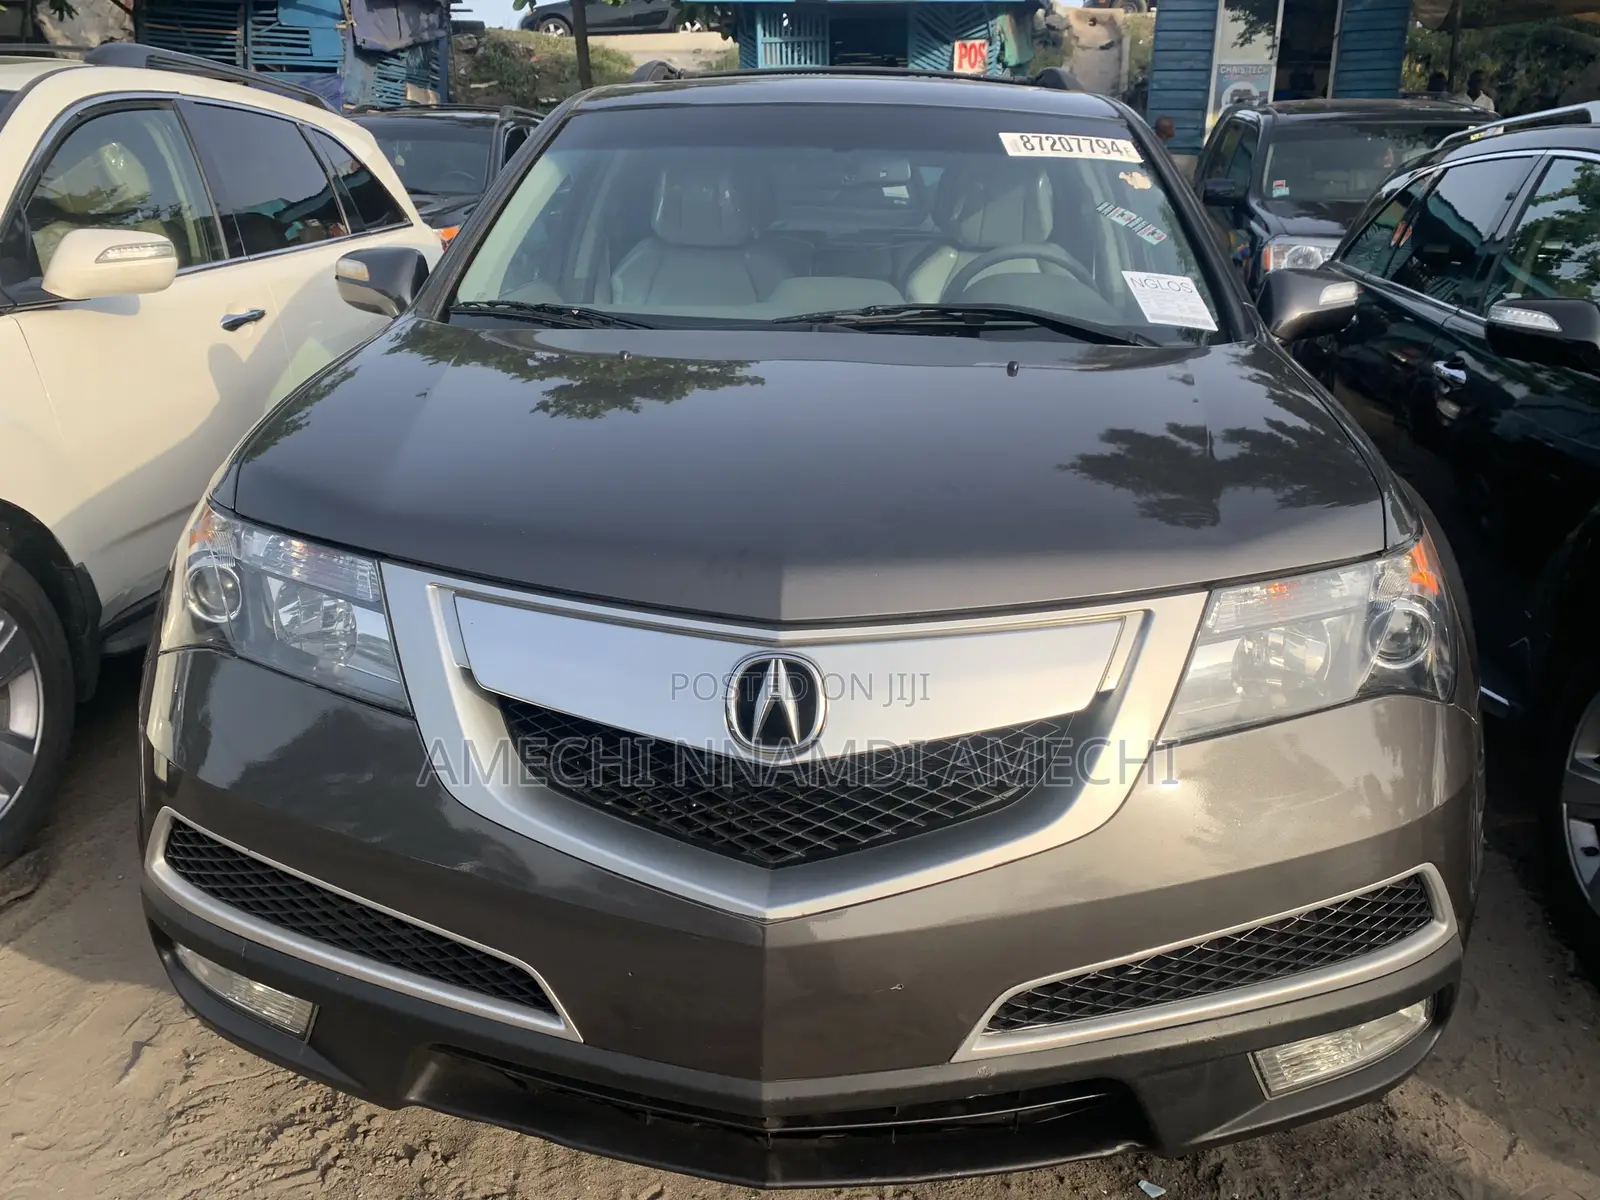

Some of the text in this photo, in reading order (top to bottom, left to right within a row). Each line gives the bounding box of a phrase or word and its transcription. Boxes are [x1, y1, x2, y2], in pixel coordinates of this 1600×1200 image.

[957, 42, 986, 69] POS
[1019, 135, 1124, 156] 87207794
[1130, 277, 1193, 294] NGLOS
